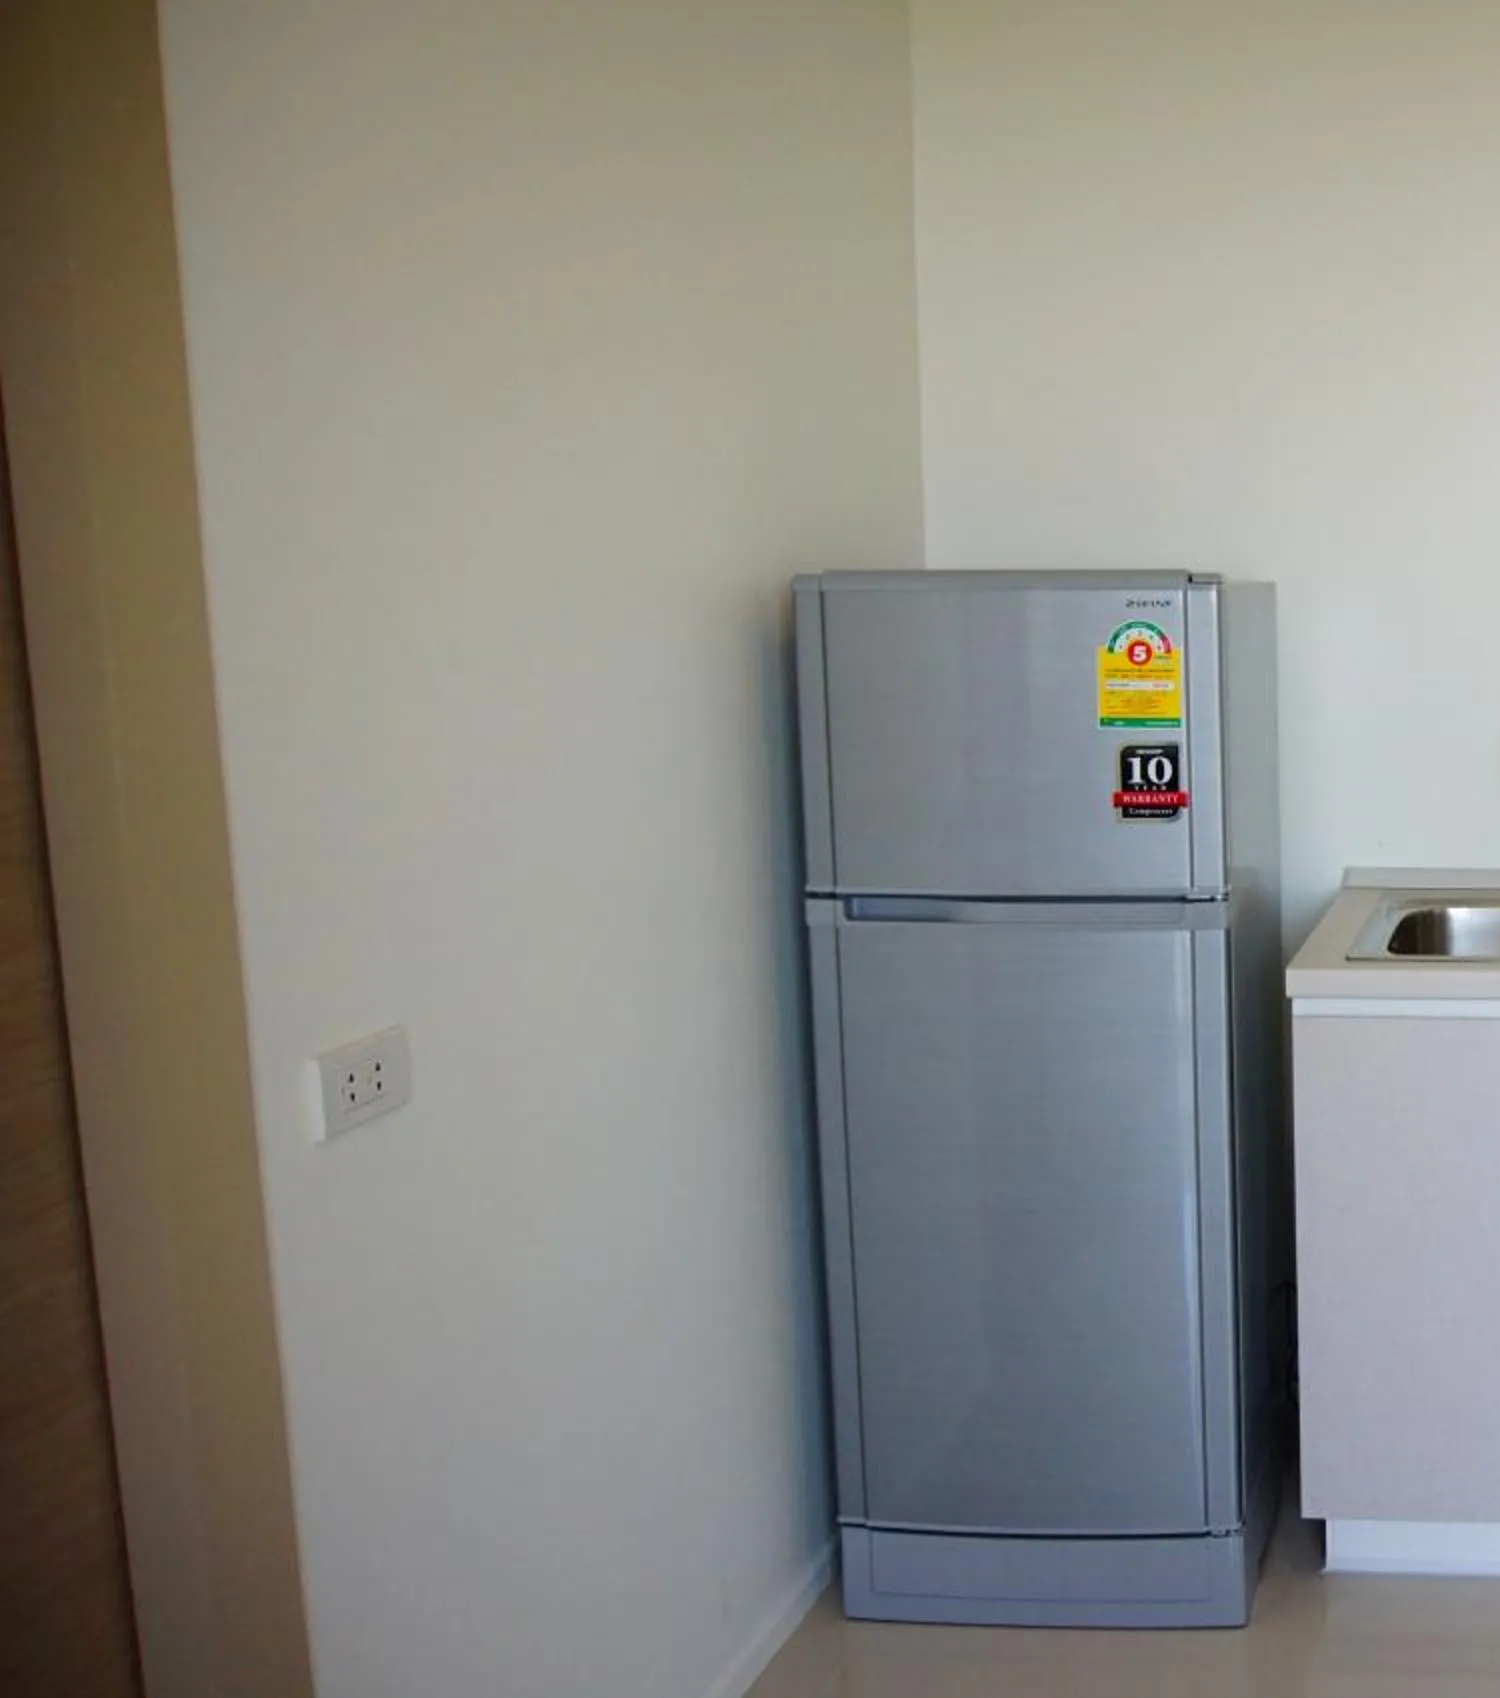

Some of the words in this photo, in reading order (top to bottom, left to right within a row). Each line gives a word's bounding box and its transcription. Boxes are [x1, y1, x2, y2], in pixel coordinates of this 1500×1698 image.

[1132, 645, 1148, 662] 5
[1127, 756, 1173, 785] 10
[1123, 795, 1179, 803] WARRANTY
